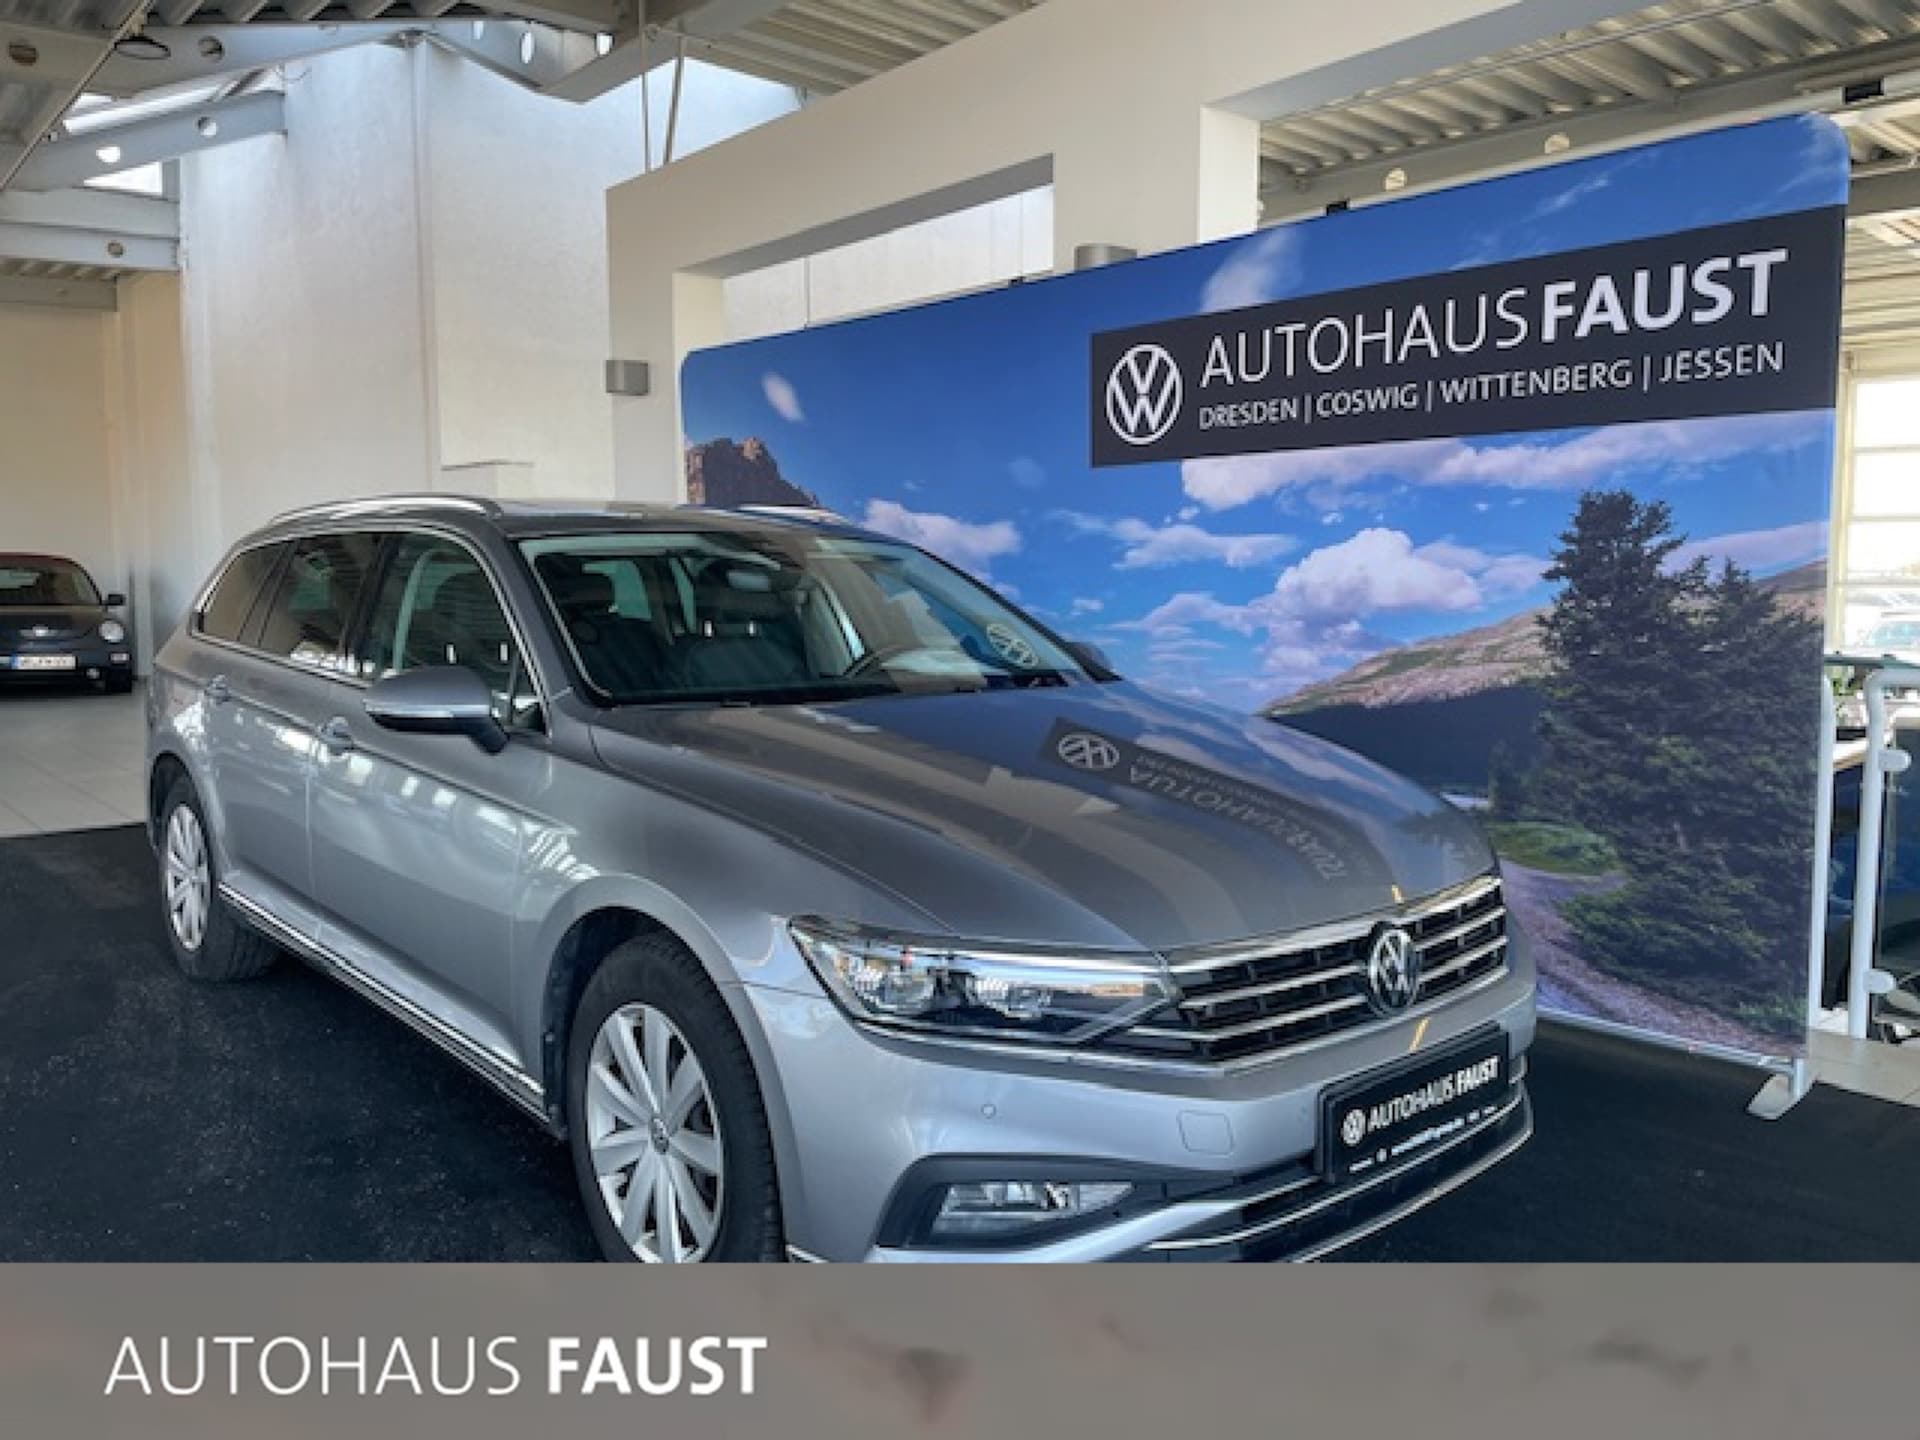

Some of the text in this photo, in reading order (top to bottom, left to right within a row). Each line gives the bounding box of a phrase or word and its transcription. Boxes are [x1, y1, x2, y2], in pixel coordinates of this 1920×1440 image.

[1200, 248, 1789, 388] AUTOHAUS FAUST
[1199, 398, 1298, 430] DRESDEN
[1316, 382, 1418, 417] COSWIG
[1439, 359, 1634, 404] WITTENBERG
[1659, 341, 1785, 384] JESSEN
[1367, 1055, 1498, 1132] AUTOHAUS FAUST
